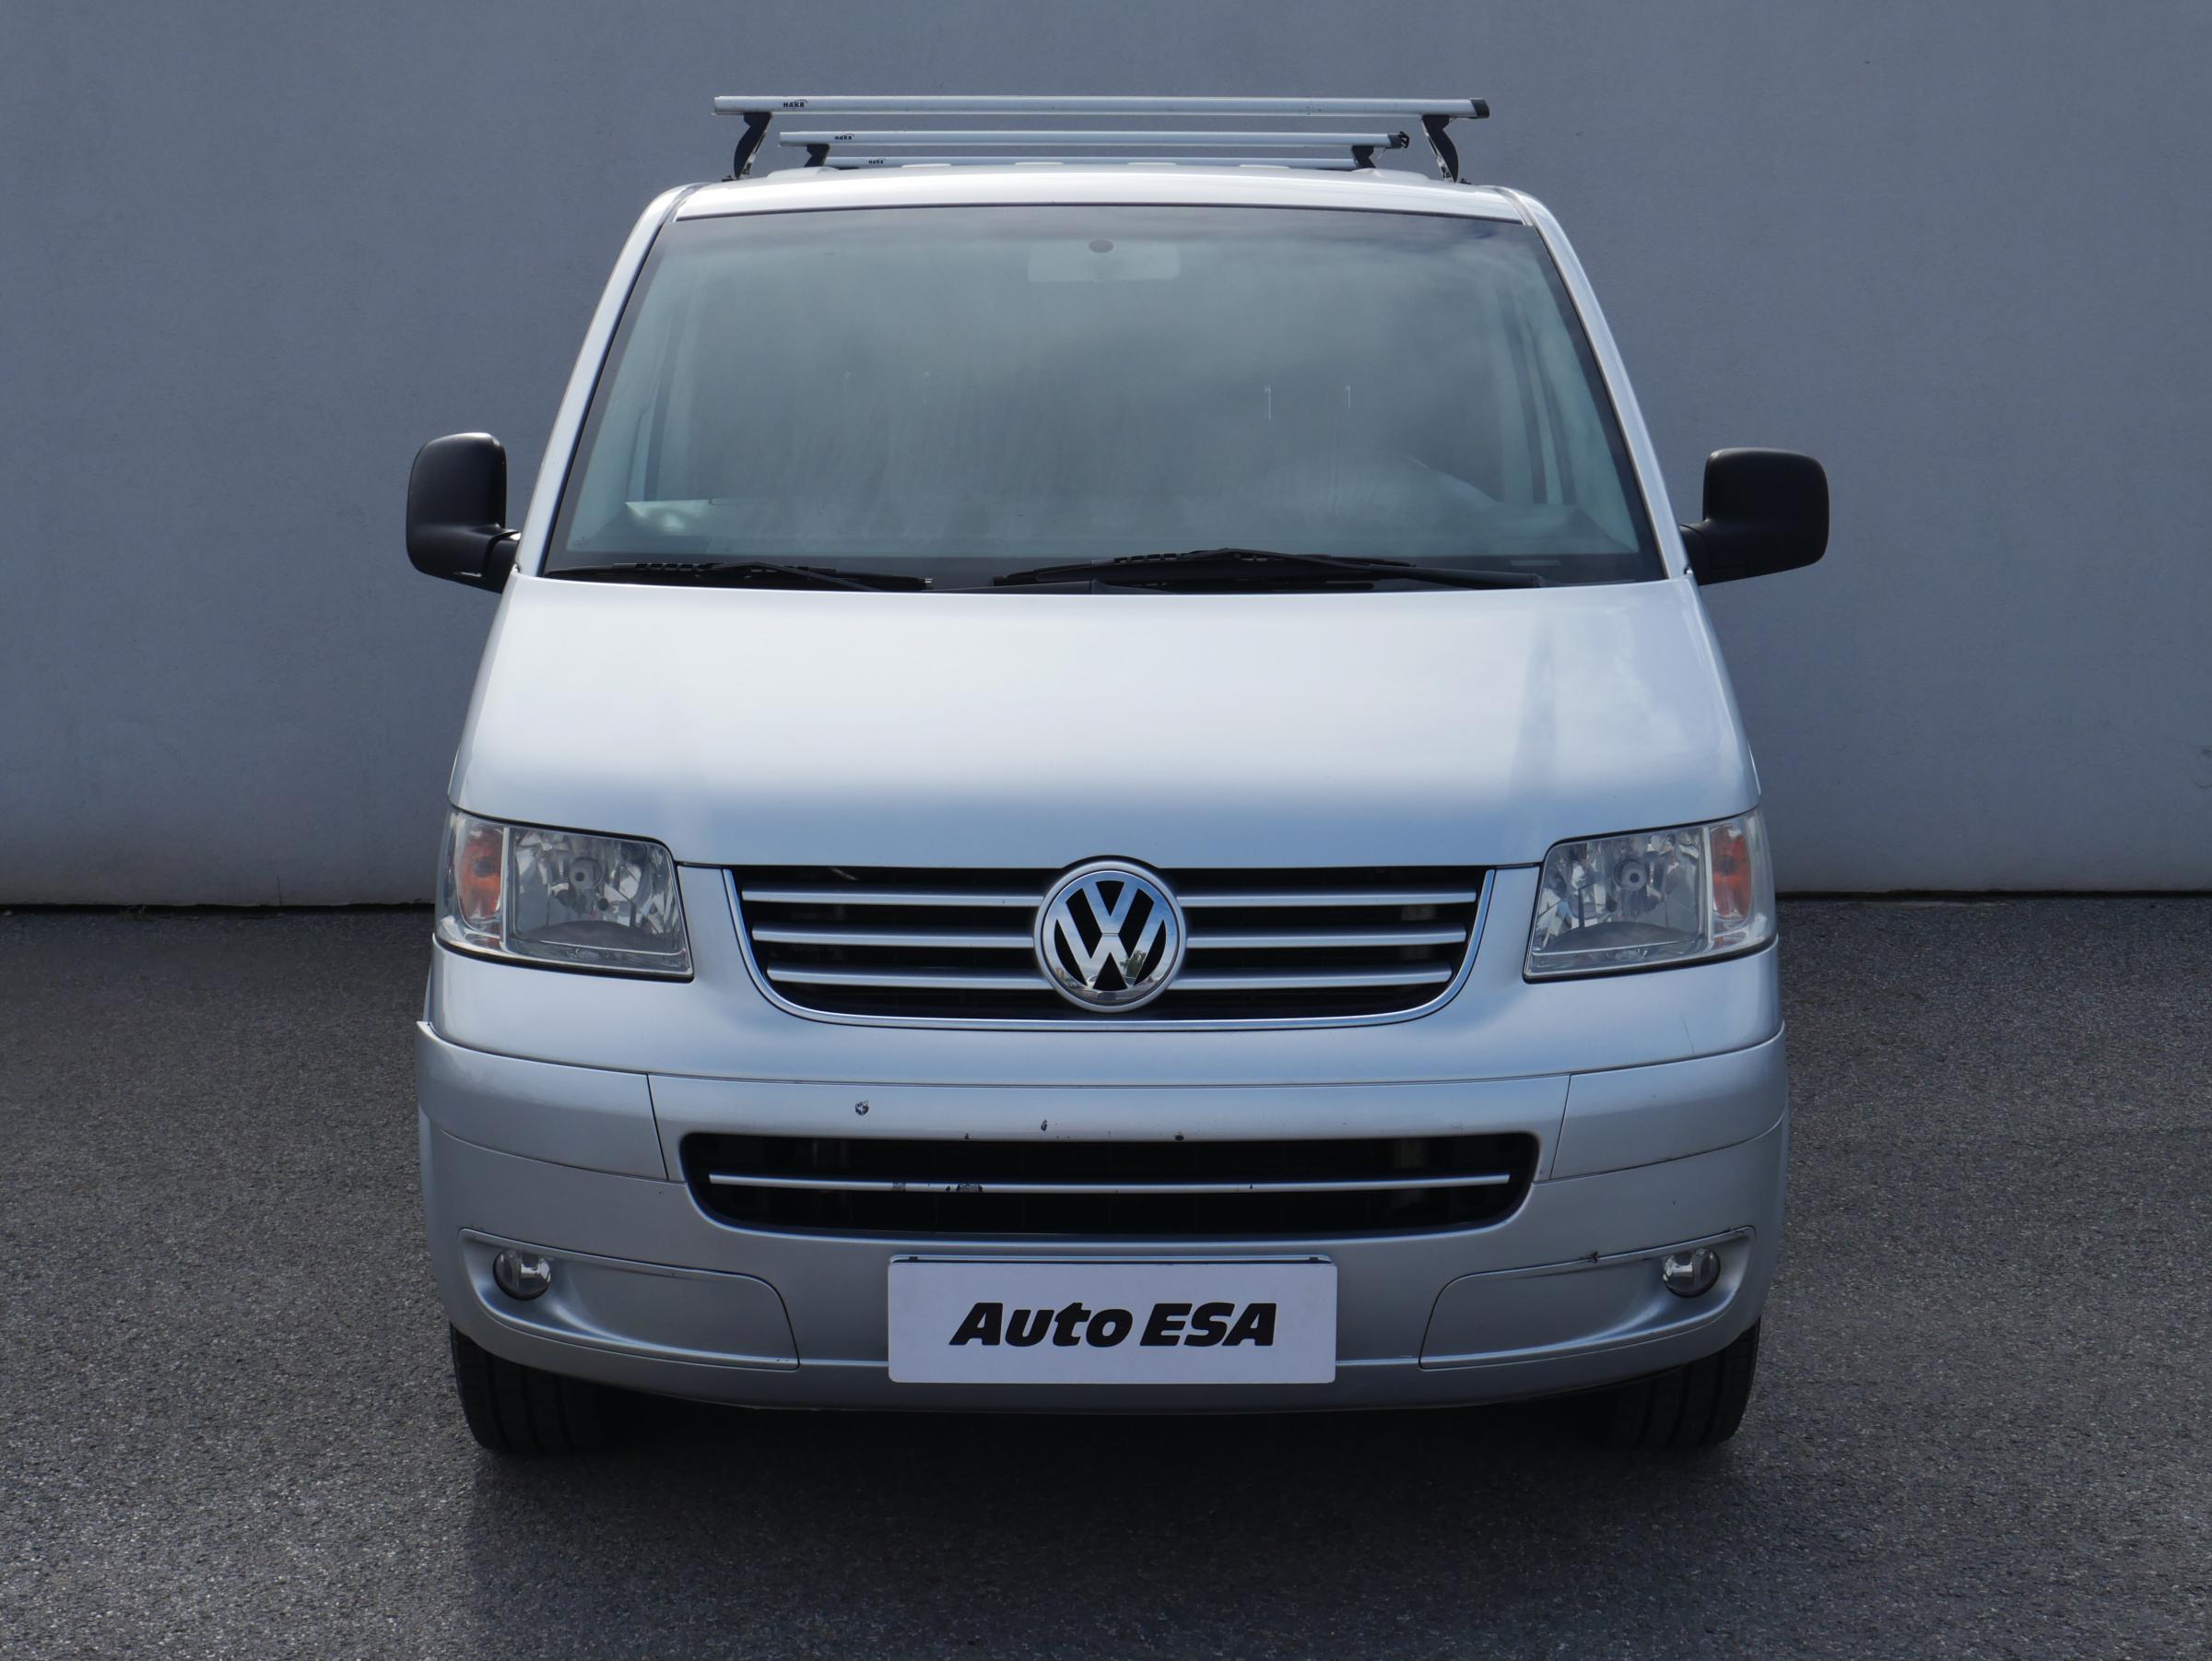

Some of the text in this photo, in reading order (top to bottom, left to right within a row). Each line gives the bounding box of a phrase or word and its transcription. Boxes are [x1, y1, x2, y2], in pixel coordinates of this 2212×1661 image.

[1043, 871, 1175, 1003] VW
[948, 1302, 1277, 1348] Auto ESA
